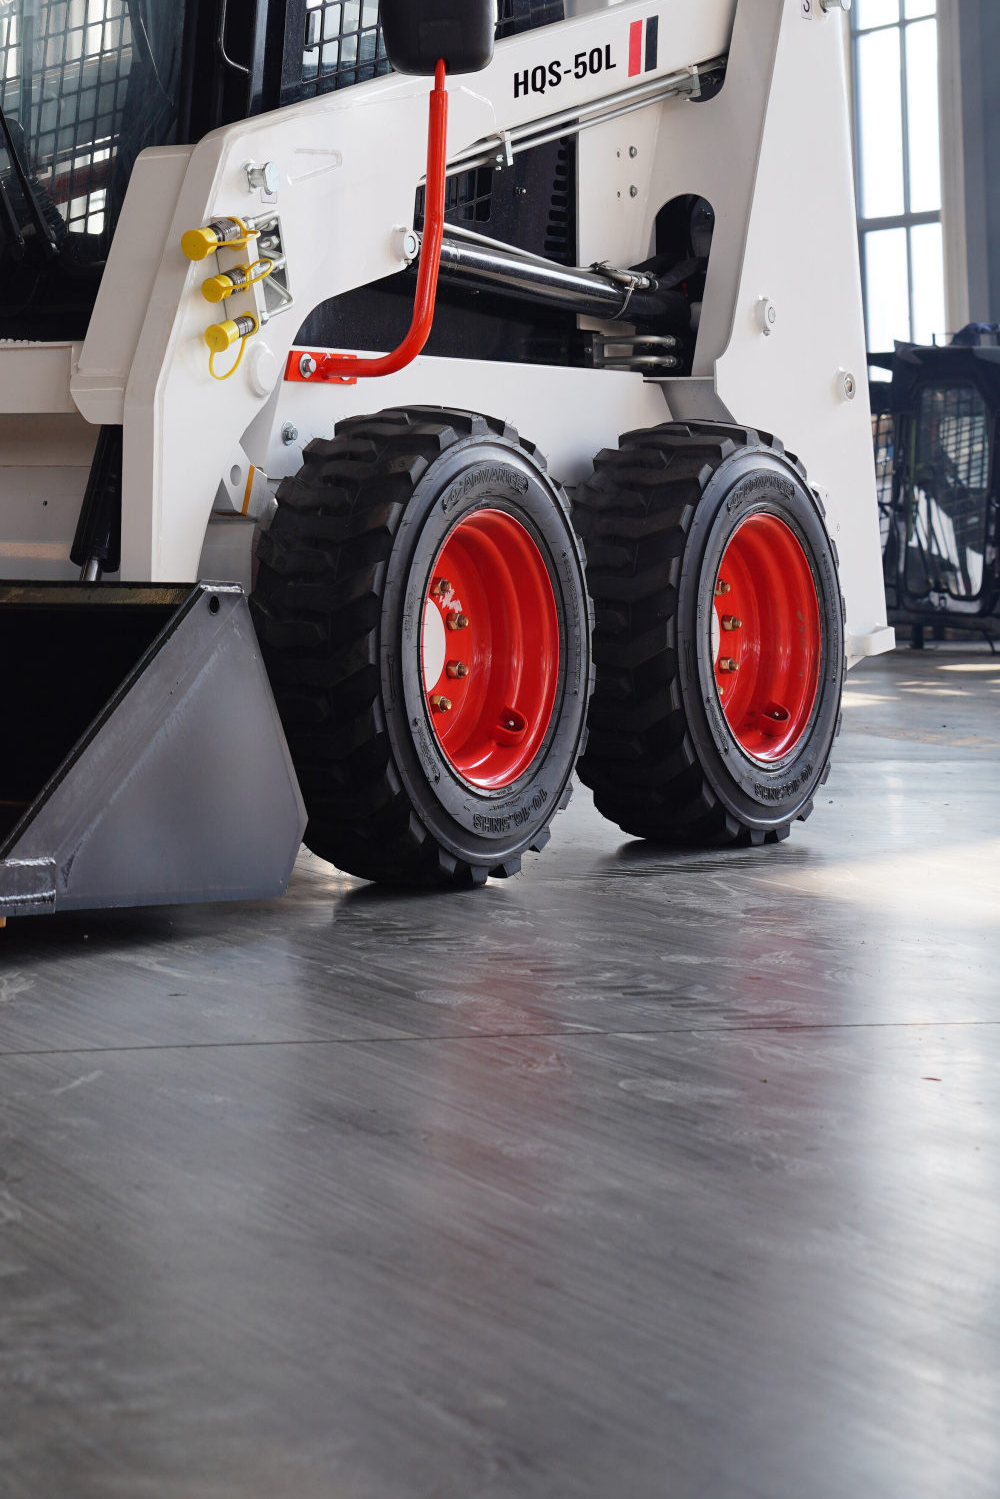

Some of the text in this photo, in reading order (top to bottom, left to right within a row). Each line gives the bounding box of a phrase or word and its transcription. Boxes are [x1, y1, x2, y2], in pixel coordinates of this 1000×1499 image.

[513, 43, 617, 98] HQS-50L
[464, 467, 526, 492] ADVANCE
[473, 788, 548, 833] 10-16.5NHS
